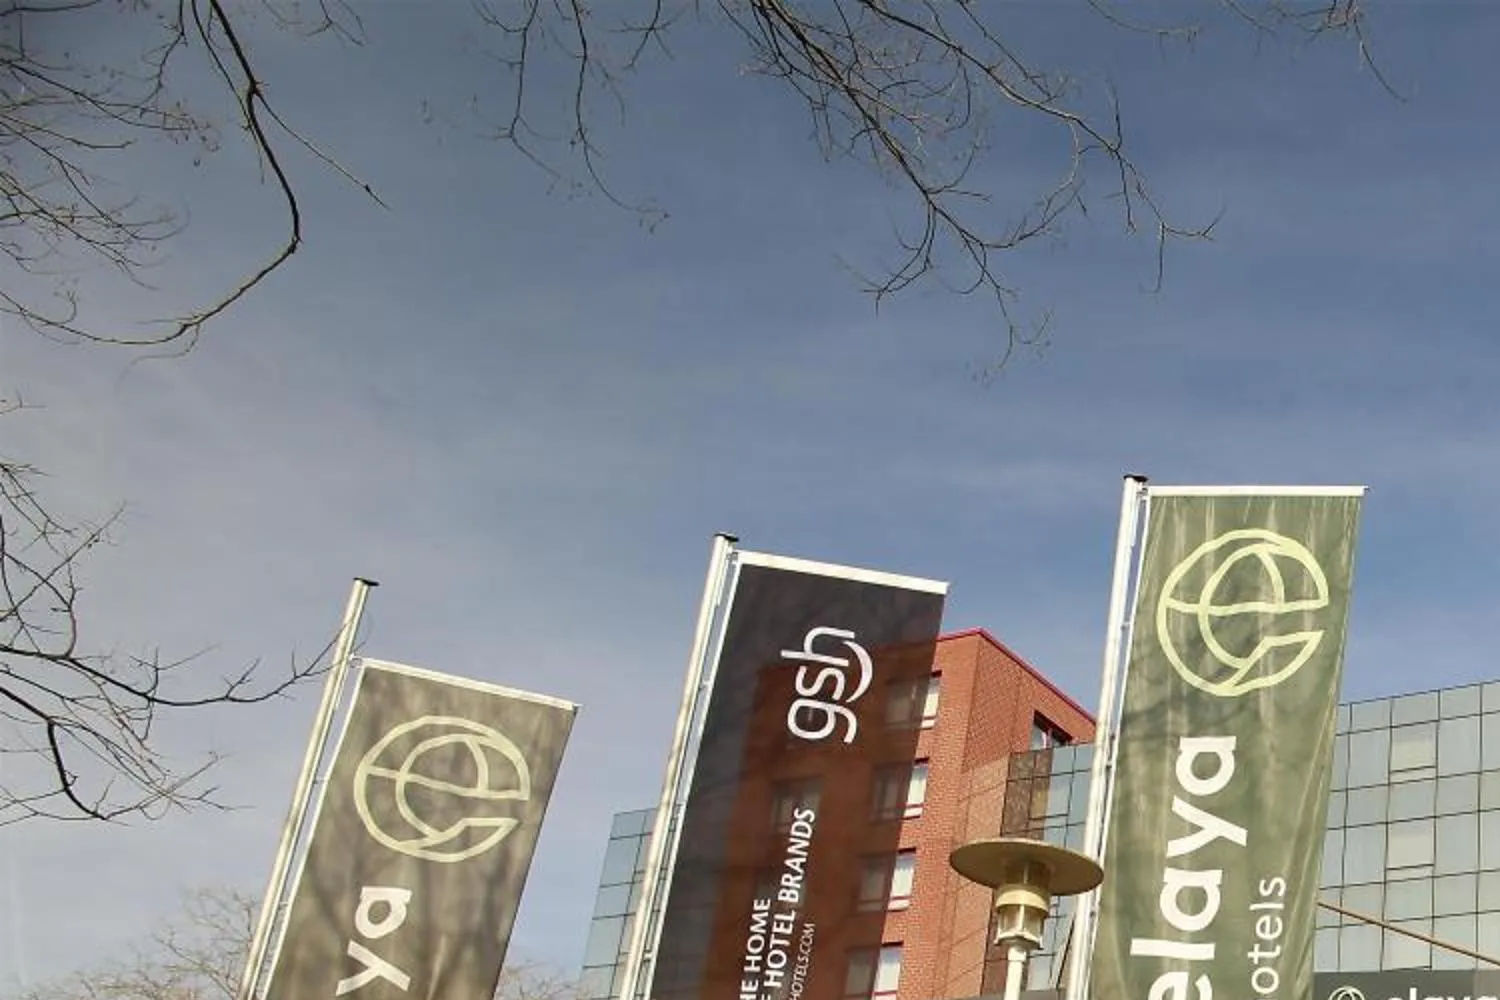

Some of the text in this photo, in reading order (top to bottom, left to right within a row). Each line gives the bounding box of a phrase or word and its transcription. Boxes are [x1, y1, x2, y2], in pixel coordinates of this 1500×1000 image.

[781, 626, 858, 744] gsh
[778, 807, 816, 903] BRANDS
[744, 898, 771, 972] HOME
[764, 909, 797, 988] HOTEL
